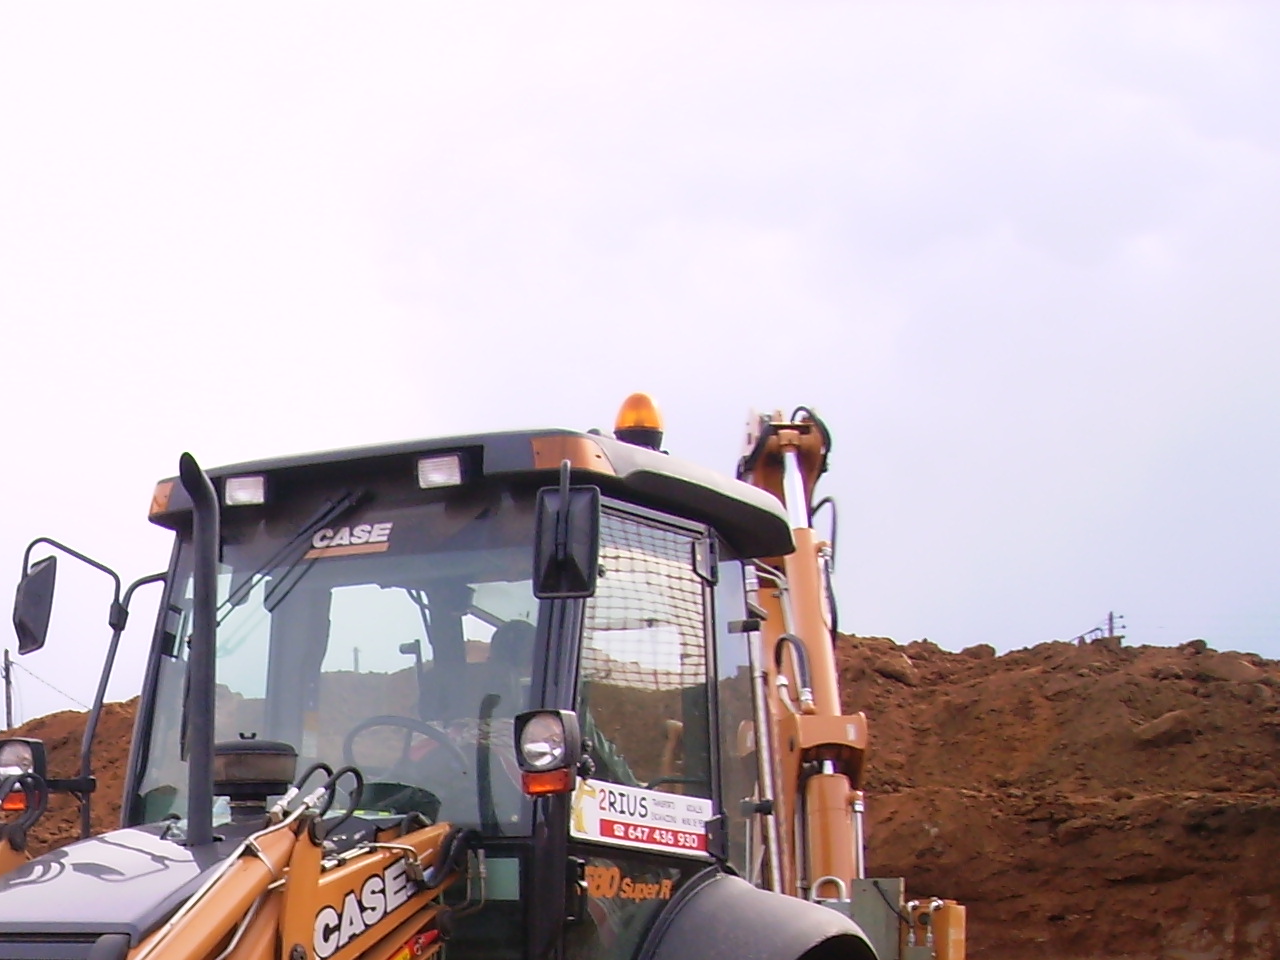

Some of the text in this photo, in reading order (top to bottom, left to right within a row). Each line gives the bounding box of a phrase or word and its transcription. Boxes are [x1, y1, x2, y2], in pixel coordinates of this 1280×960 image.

[312, 522, 393, 548] CASE
[599, 788, 648, 818] 2RIUS
[627, 825, 698, 848] 647 436 930
[621, 877, 660, 902] Super
[660, 879, 673, 899] R
[313, 857, 418, 959] CASE
